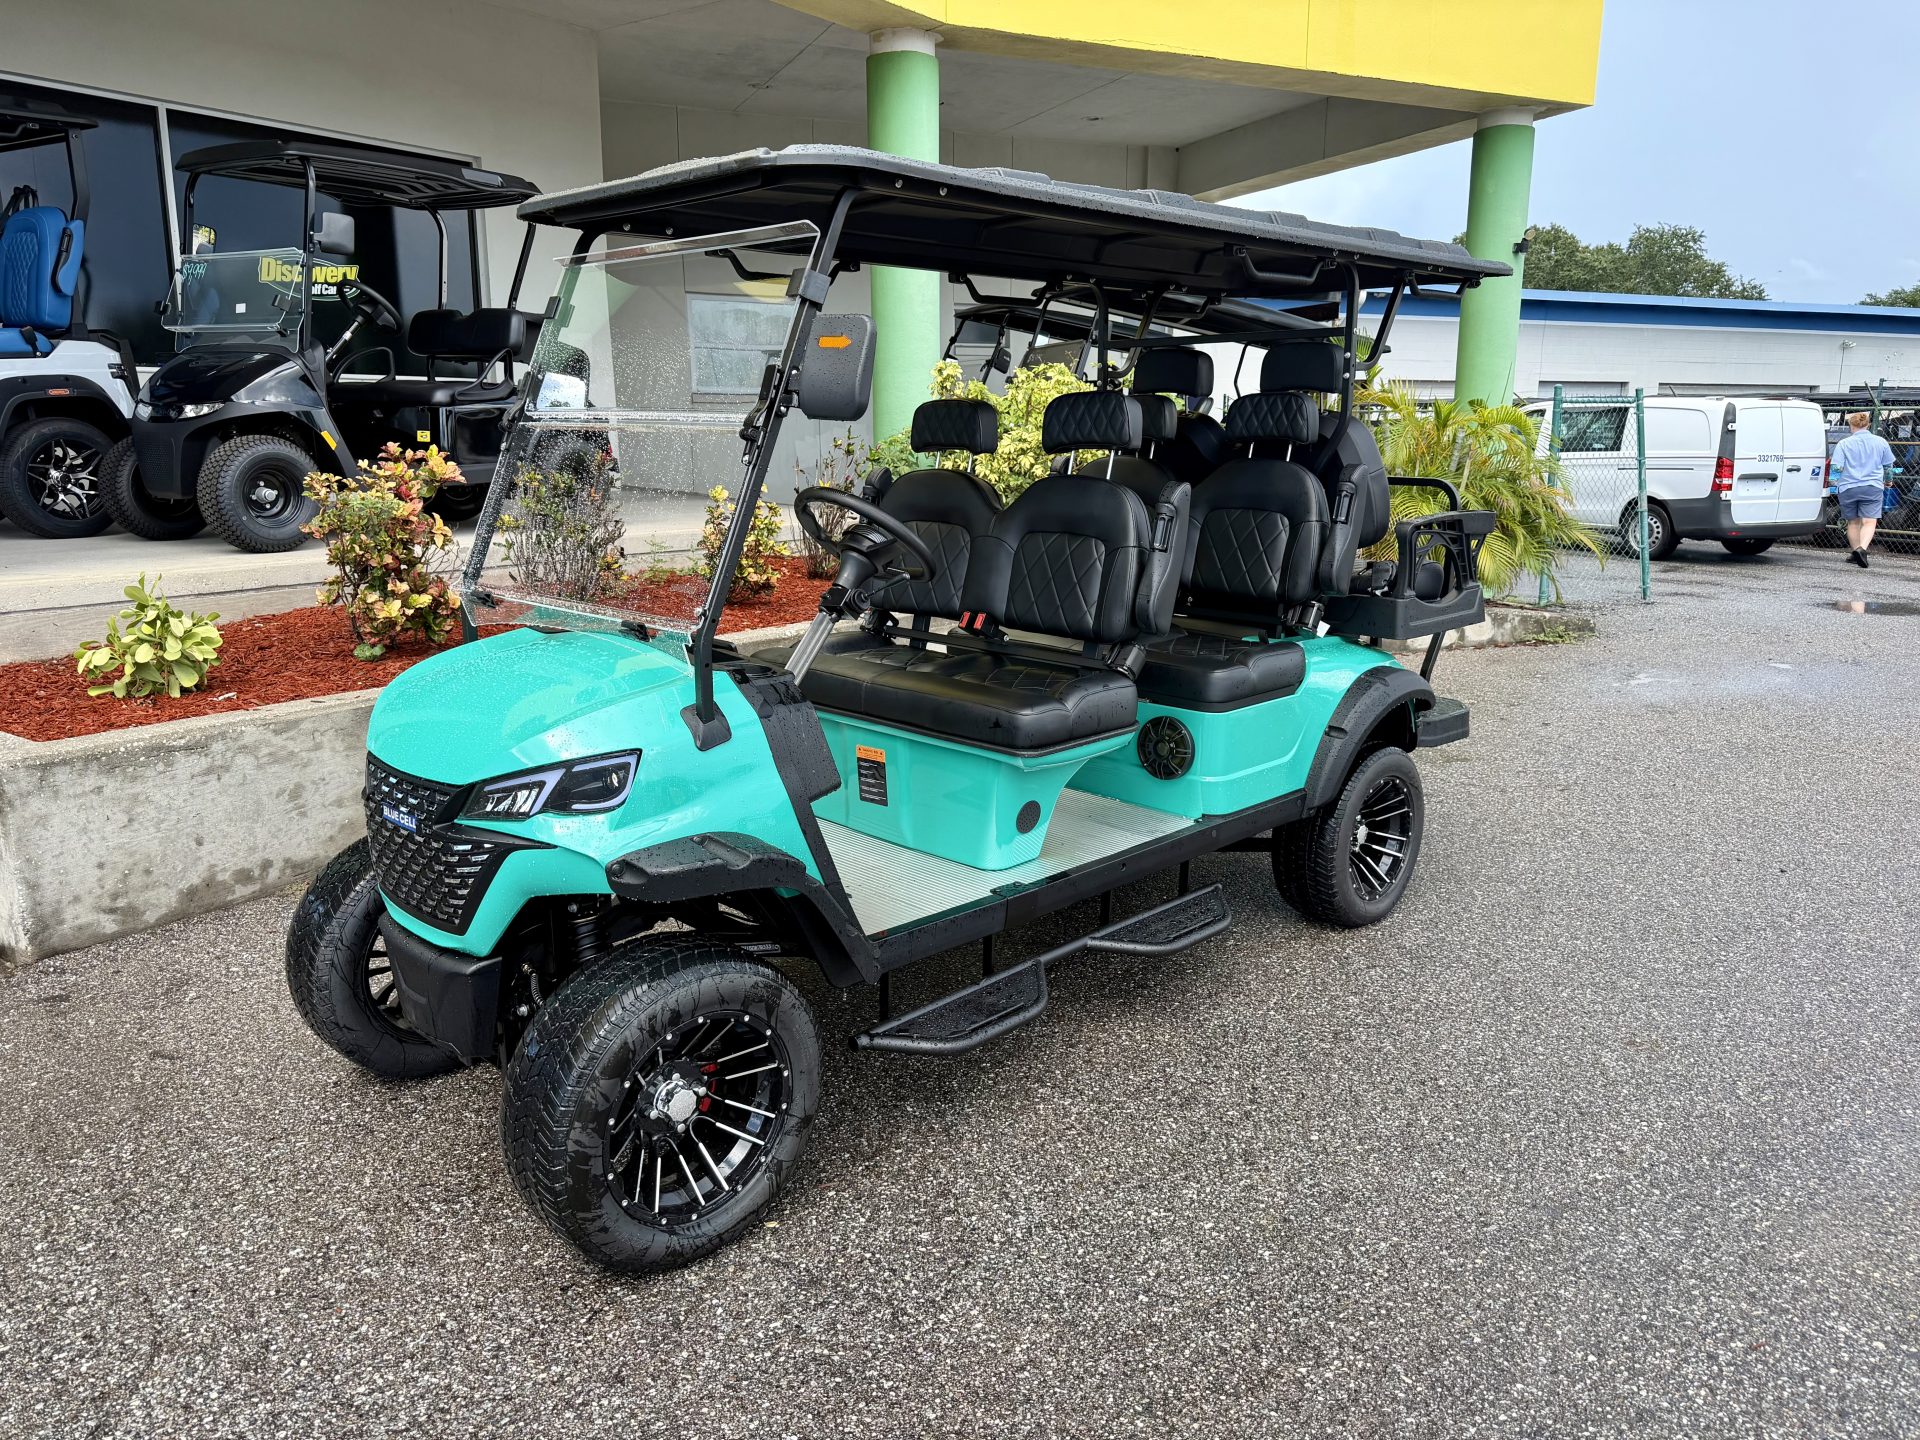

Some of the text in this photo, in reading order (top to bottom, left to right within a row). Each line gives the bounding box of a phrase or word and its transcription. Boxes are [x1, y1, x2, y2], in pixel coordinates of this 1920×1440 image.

[260, 257, 357, 283] Discvery
[1757, 454, 1784, 463] 3321769
[383, 805, 417, 829] BLUE CELL
